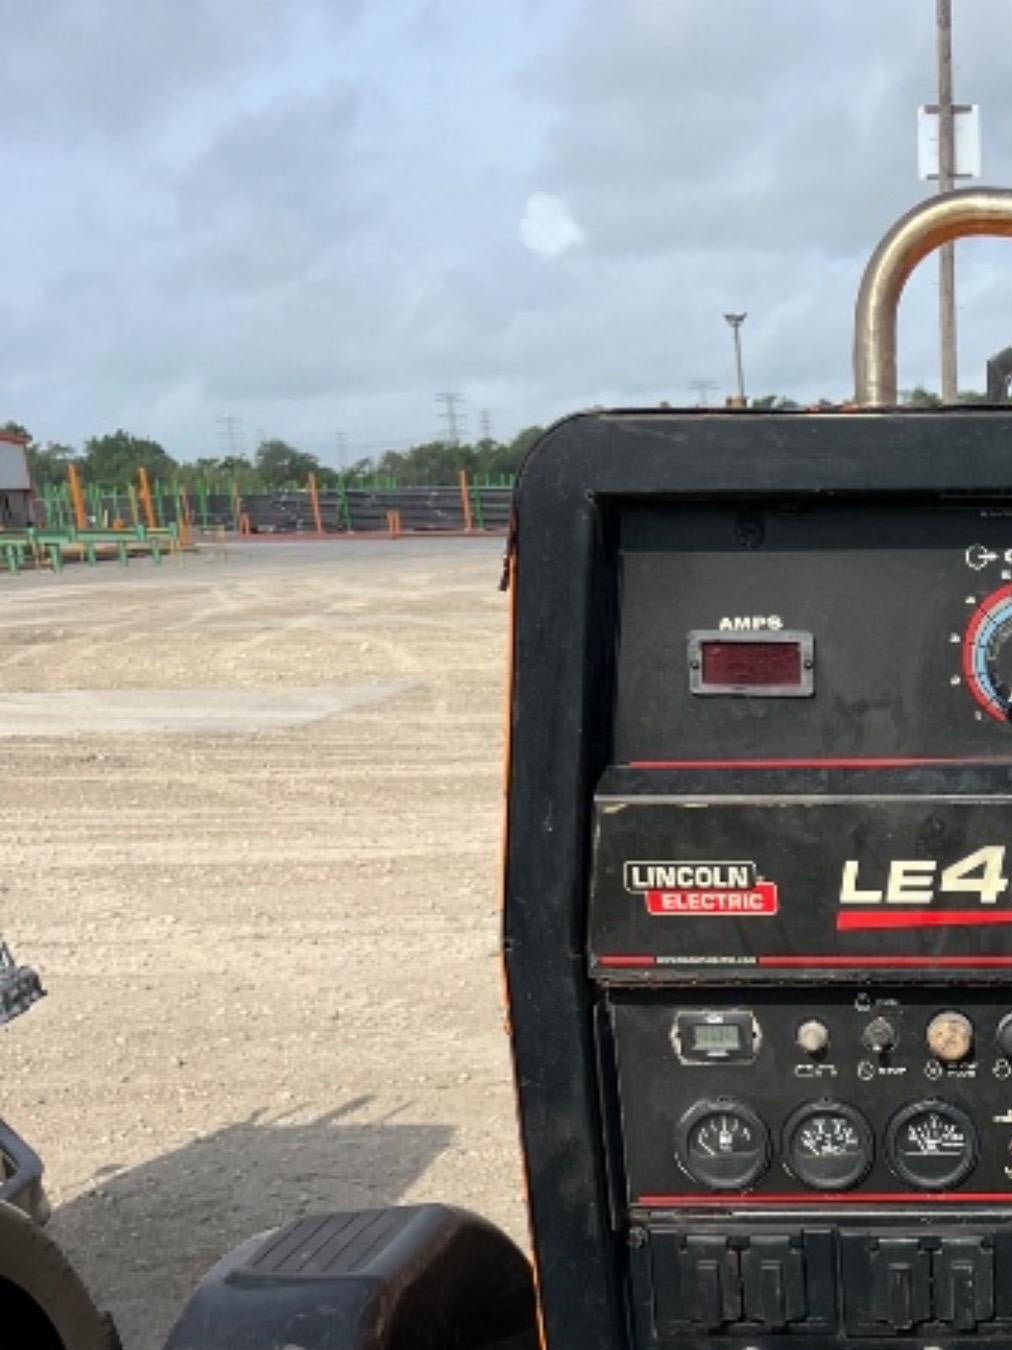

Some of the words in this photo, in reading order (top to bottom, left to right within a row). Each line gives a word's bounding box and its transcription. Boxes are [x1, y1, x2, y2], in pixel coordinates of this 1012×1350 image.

[719, 615, 784, 632] AMPS
[632, 866, 749, 888] LINCOLN
[661, 893, 765, 911] ELECTRIC
